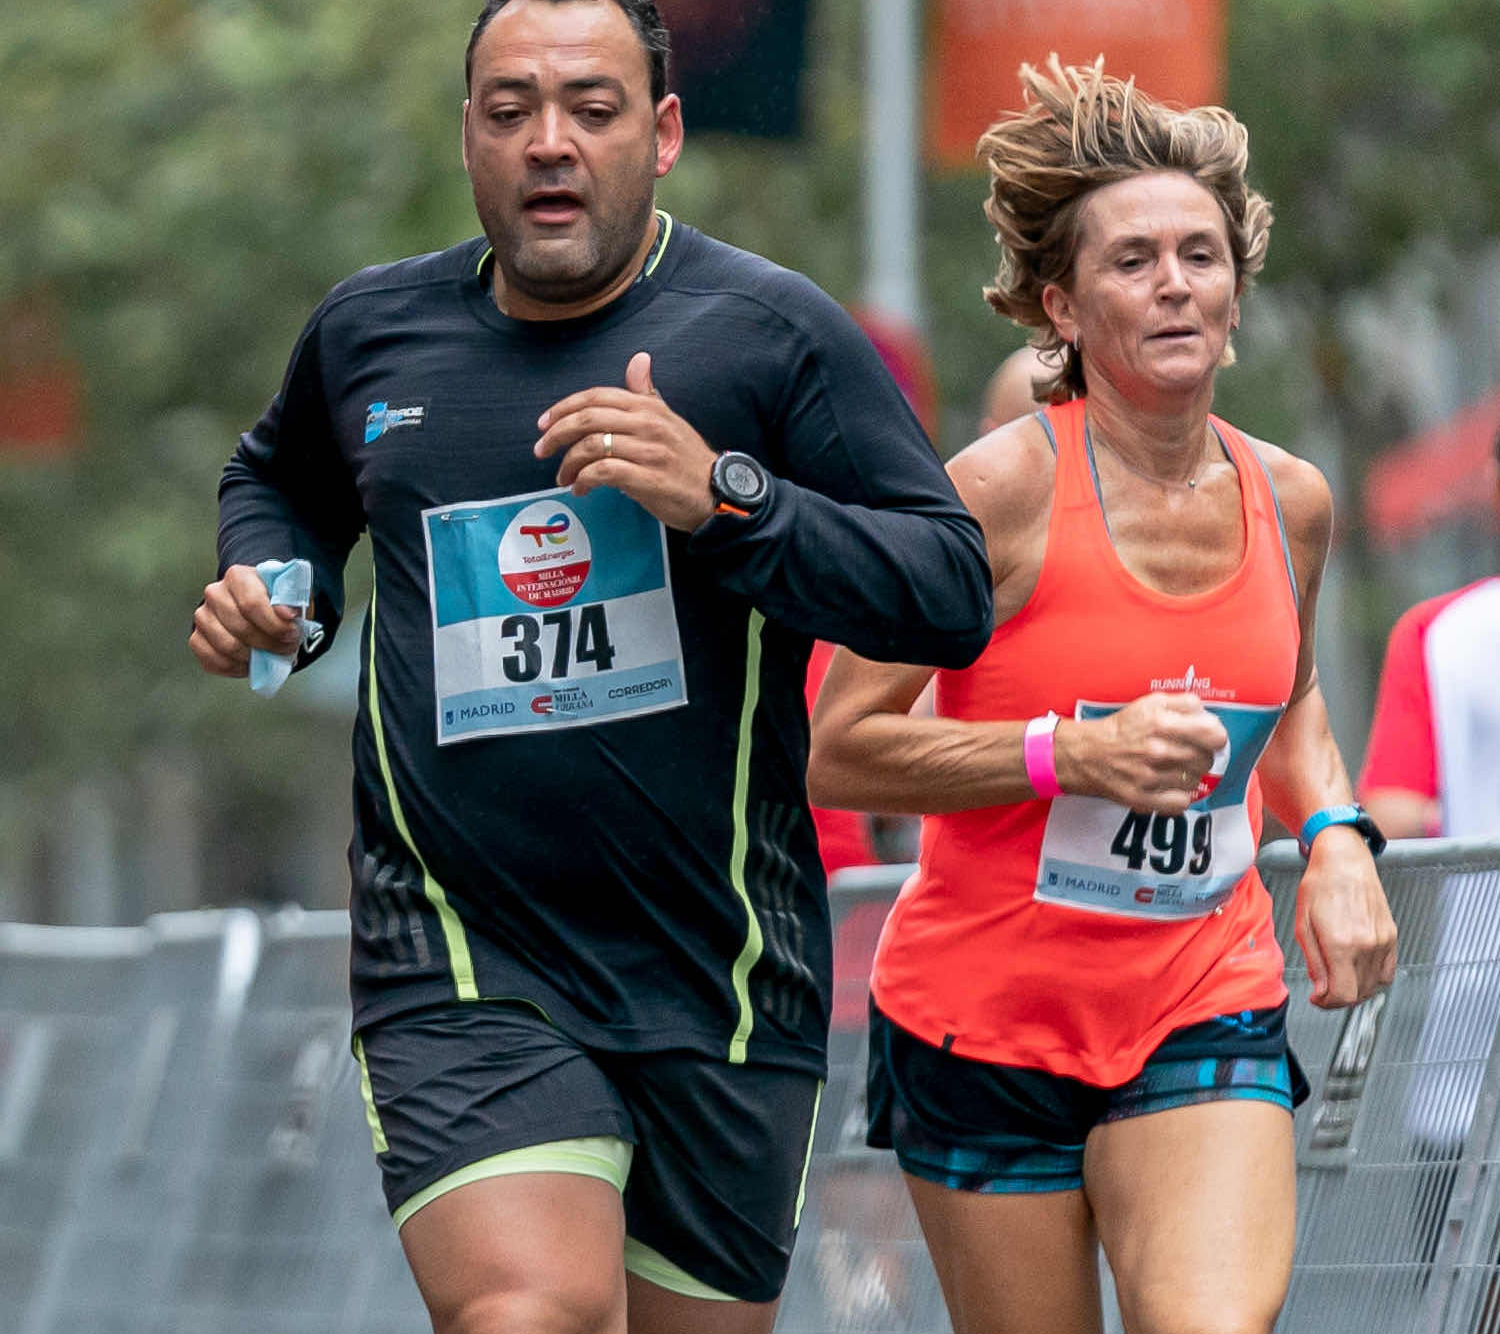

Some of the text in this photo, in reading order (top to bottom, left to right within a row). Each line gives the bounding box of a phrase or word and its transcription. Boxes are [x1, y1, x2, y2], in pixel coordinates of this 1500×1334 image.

[522, 548, 575, 564] TotalEnergies
[538, 570, 565, 580] MILLA
[528, 592, 541, 600] DE
[500, 603, 616, 684] 374
[460, 702, 516, 721] MADRID
[1110, 810, 1213, 875] 499
[1065, 875, 1121, 896] MADRID
